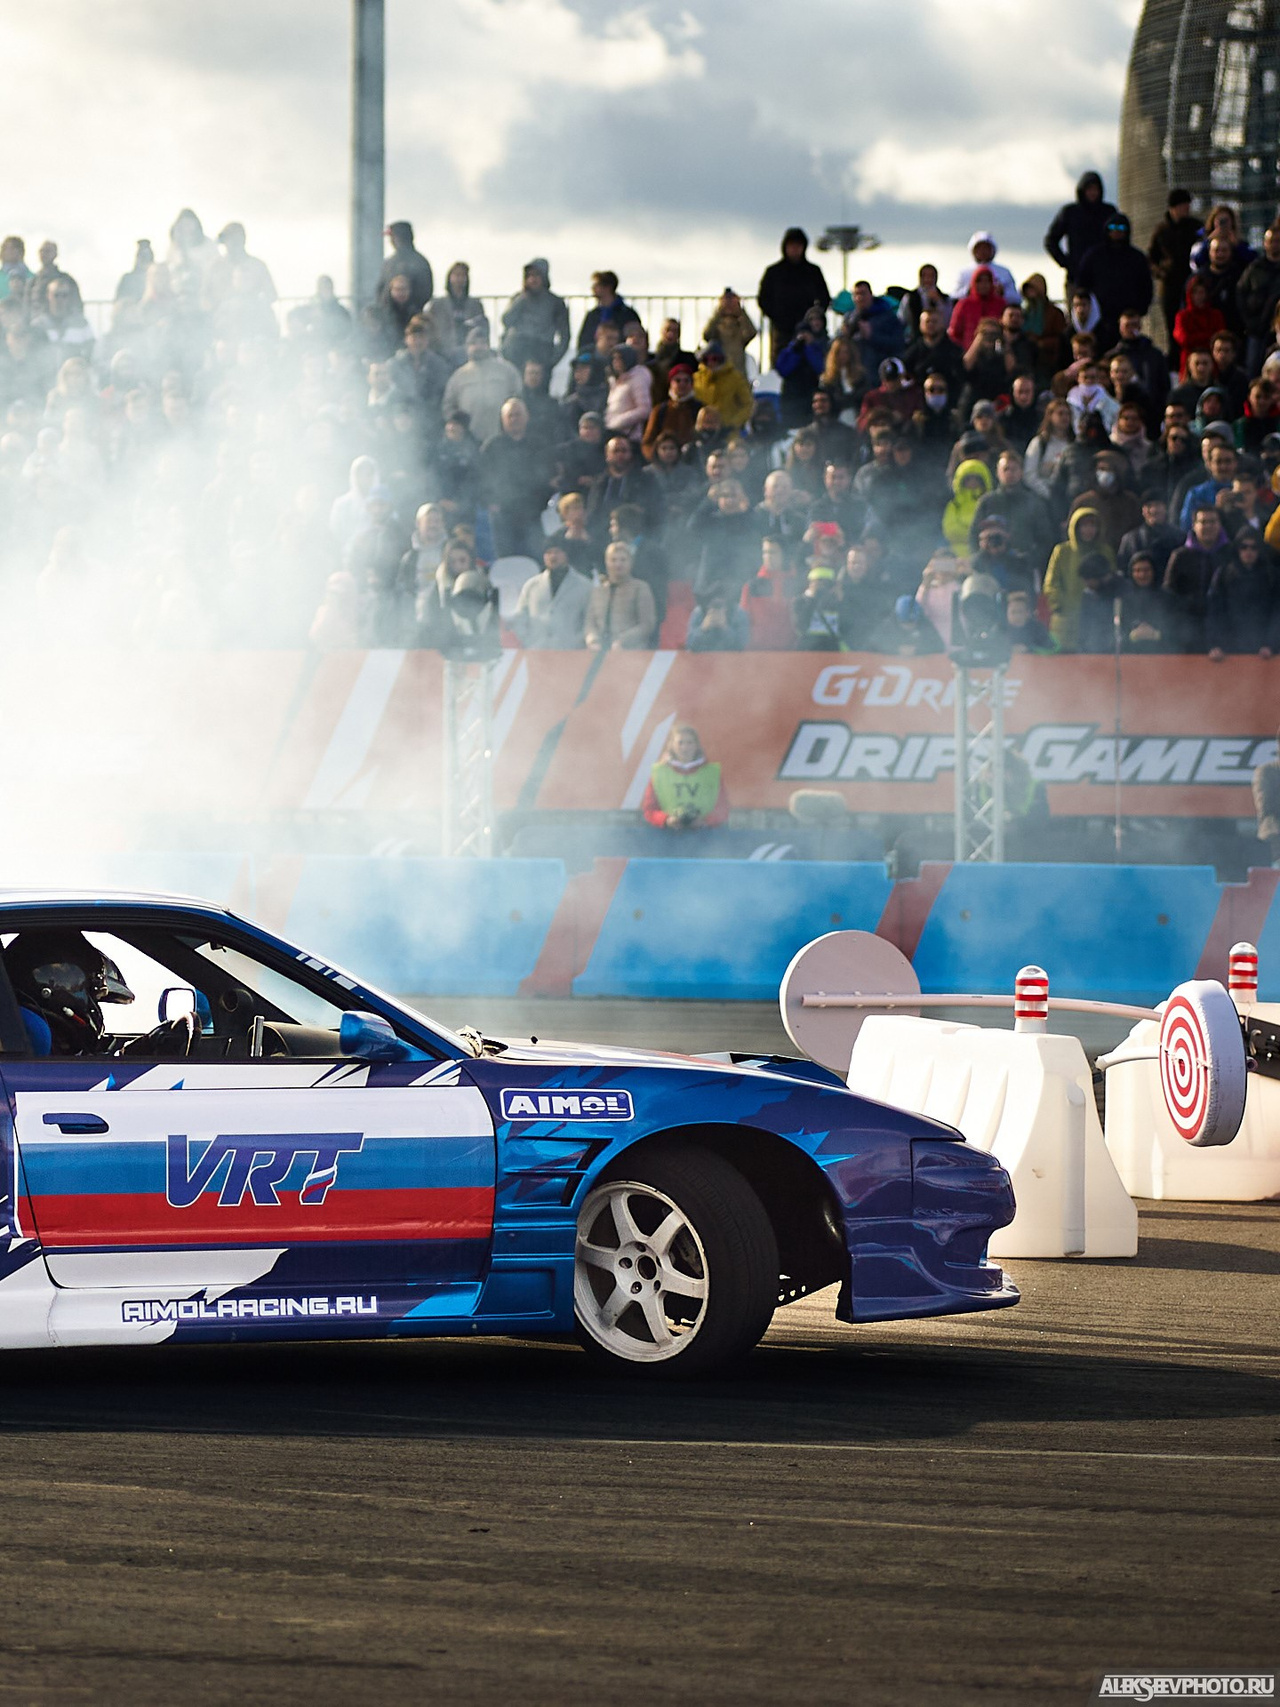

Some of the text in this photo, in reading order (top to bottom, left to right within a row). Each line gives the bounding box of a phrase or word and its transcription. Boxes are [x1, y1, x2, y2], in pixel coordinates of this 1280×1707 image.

[674, 783, 700, 798] TV
[507, 1096, 628, 1115] AIMOL
[166, 1133, 364, 1208] VRT
[123, 1296, 378, 1321] AIMOLRACING.RU
